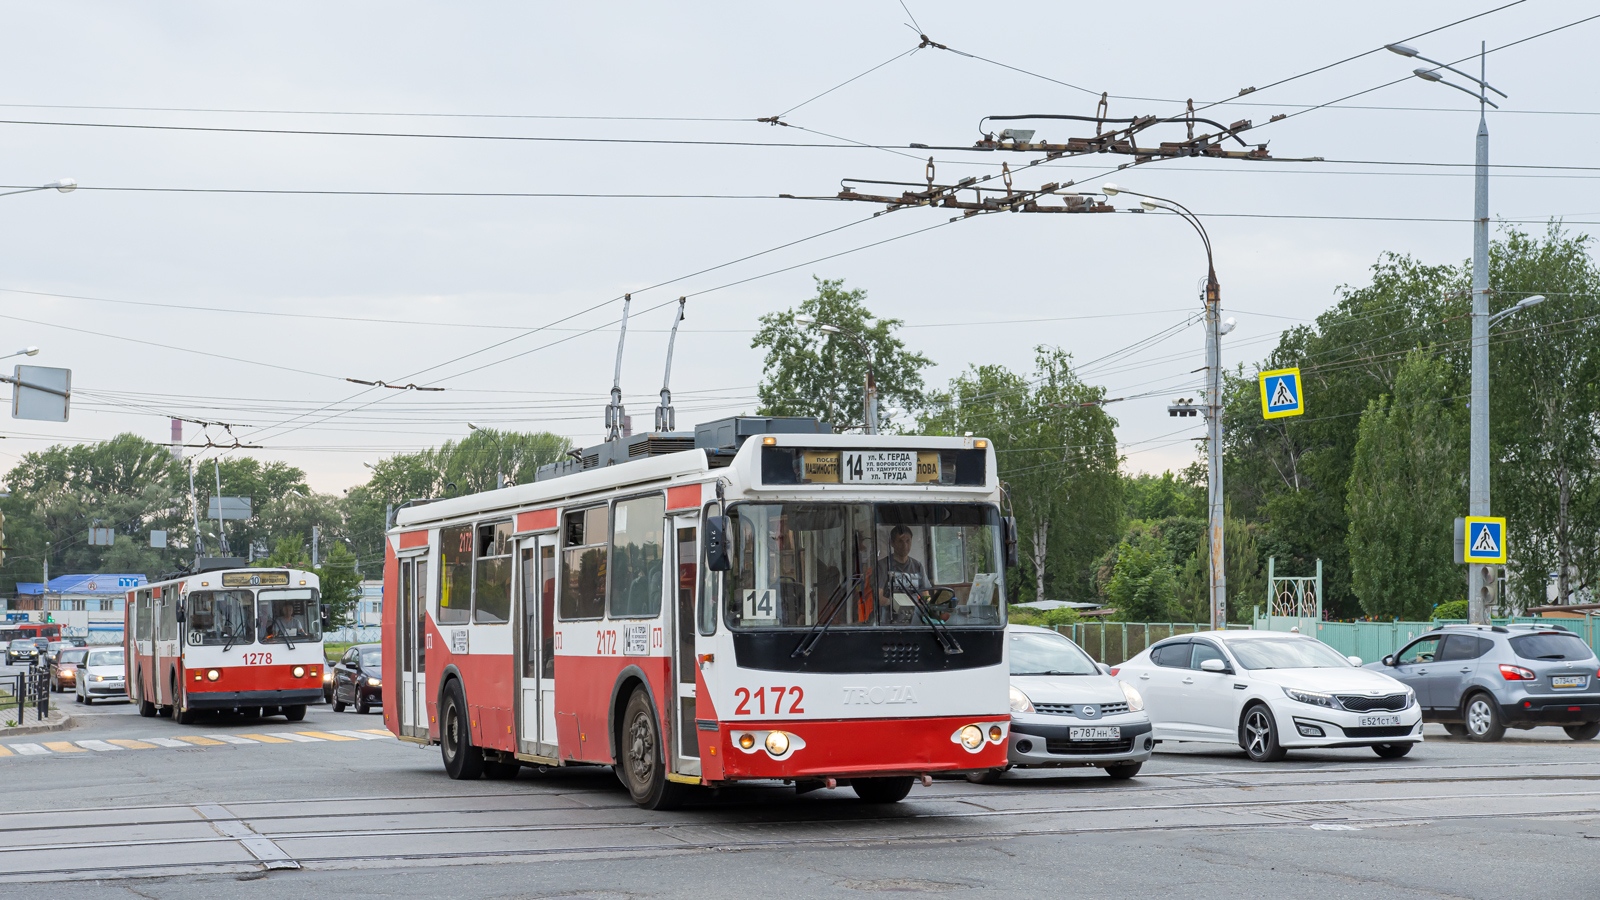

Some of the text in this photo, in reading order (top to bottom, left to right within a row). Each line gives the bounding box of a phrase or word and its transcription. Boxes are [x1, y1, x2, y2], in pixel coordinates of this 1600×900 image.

[887, 453, 911, 462] ГЕРДА
[846, 454, 864, 481] 14
[917, 463, 938, 475] ЛОВА
[883, 472, 908, 481] ТРУДА
[459, 531, 473, 553] 2172
[251, 576, 259, 585] 10
[746, 590, 773, 617] 14
[190, 632, 202, 644] 10
[596, 629, 617, 655] 2172
[242, 652, 273, 665] 1278
[734, 685, 805, 716] 2172
